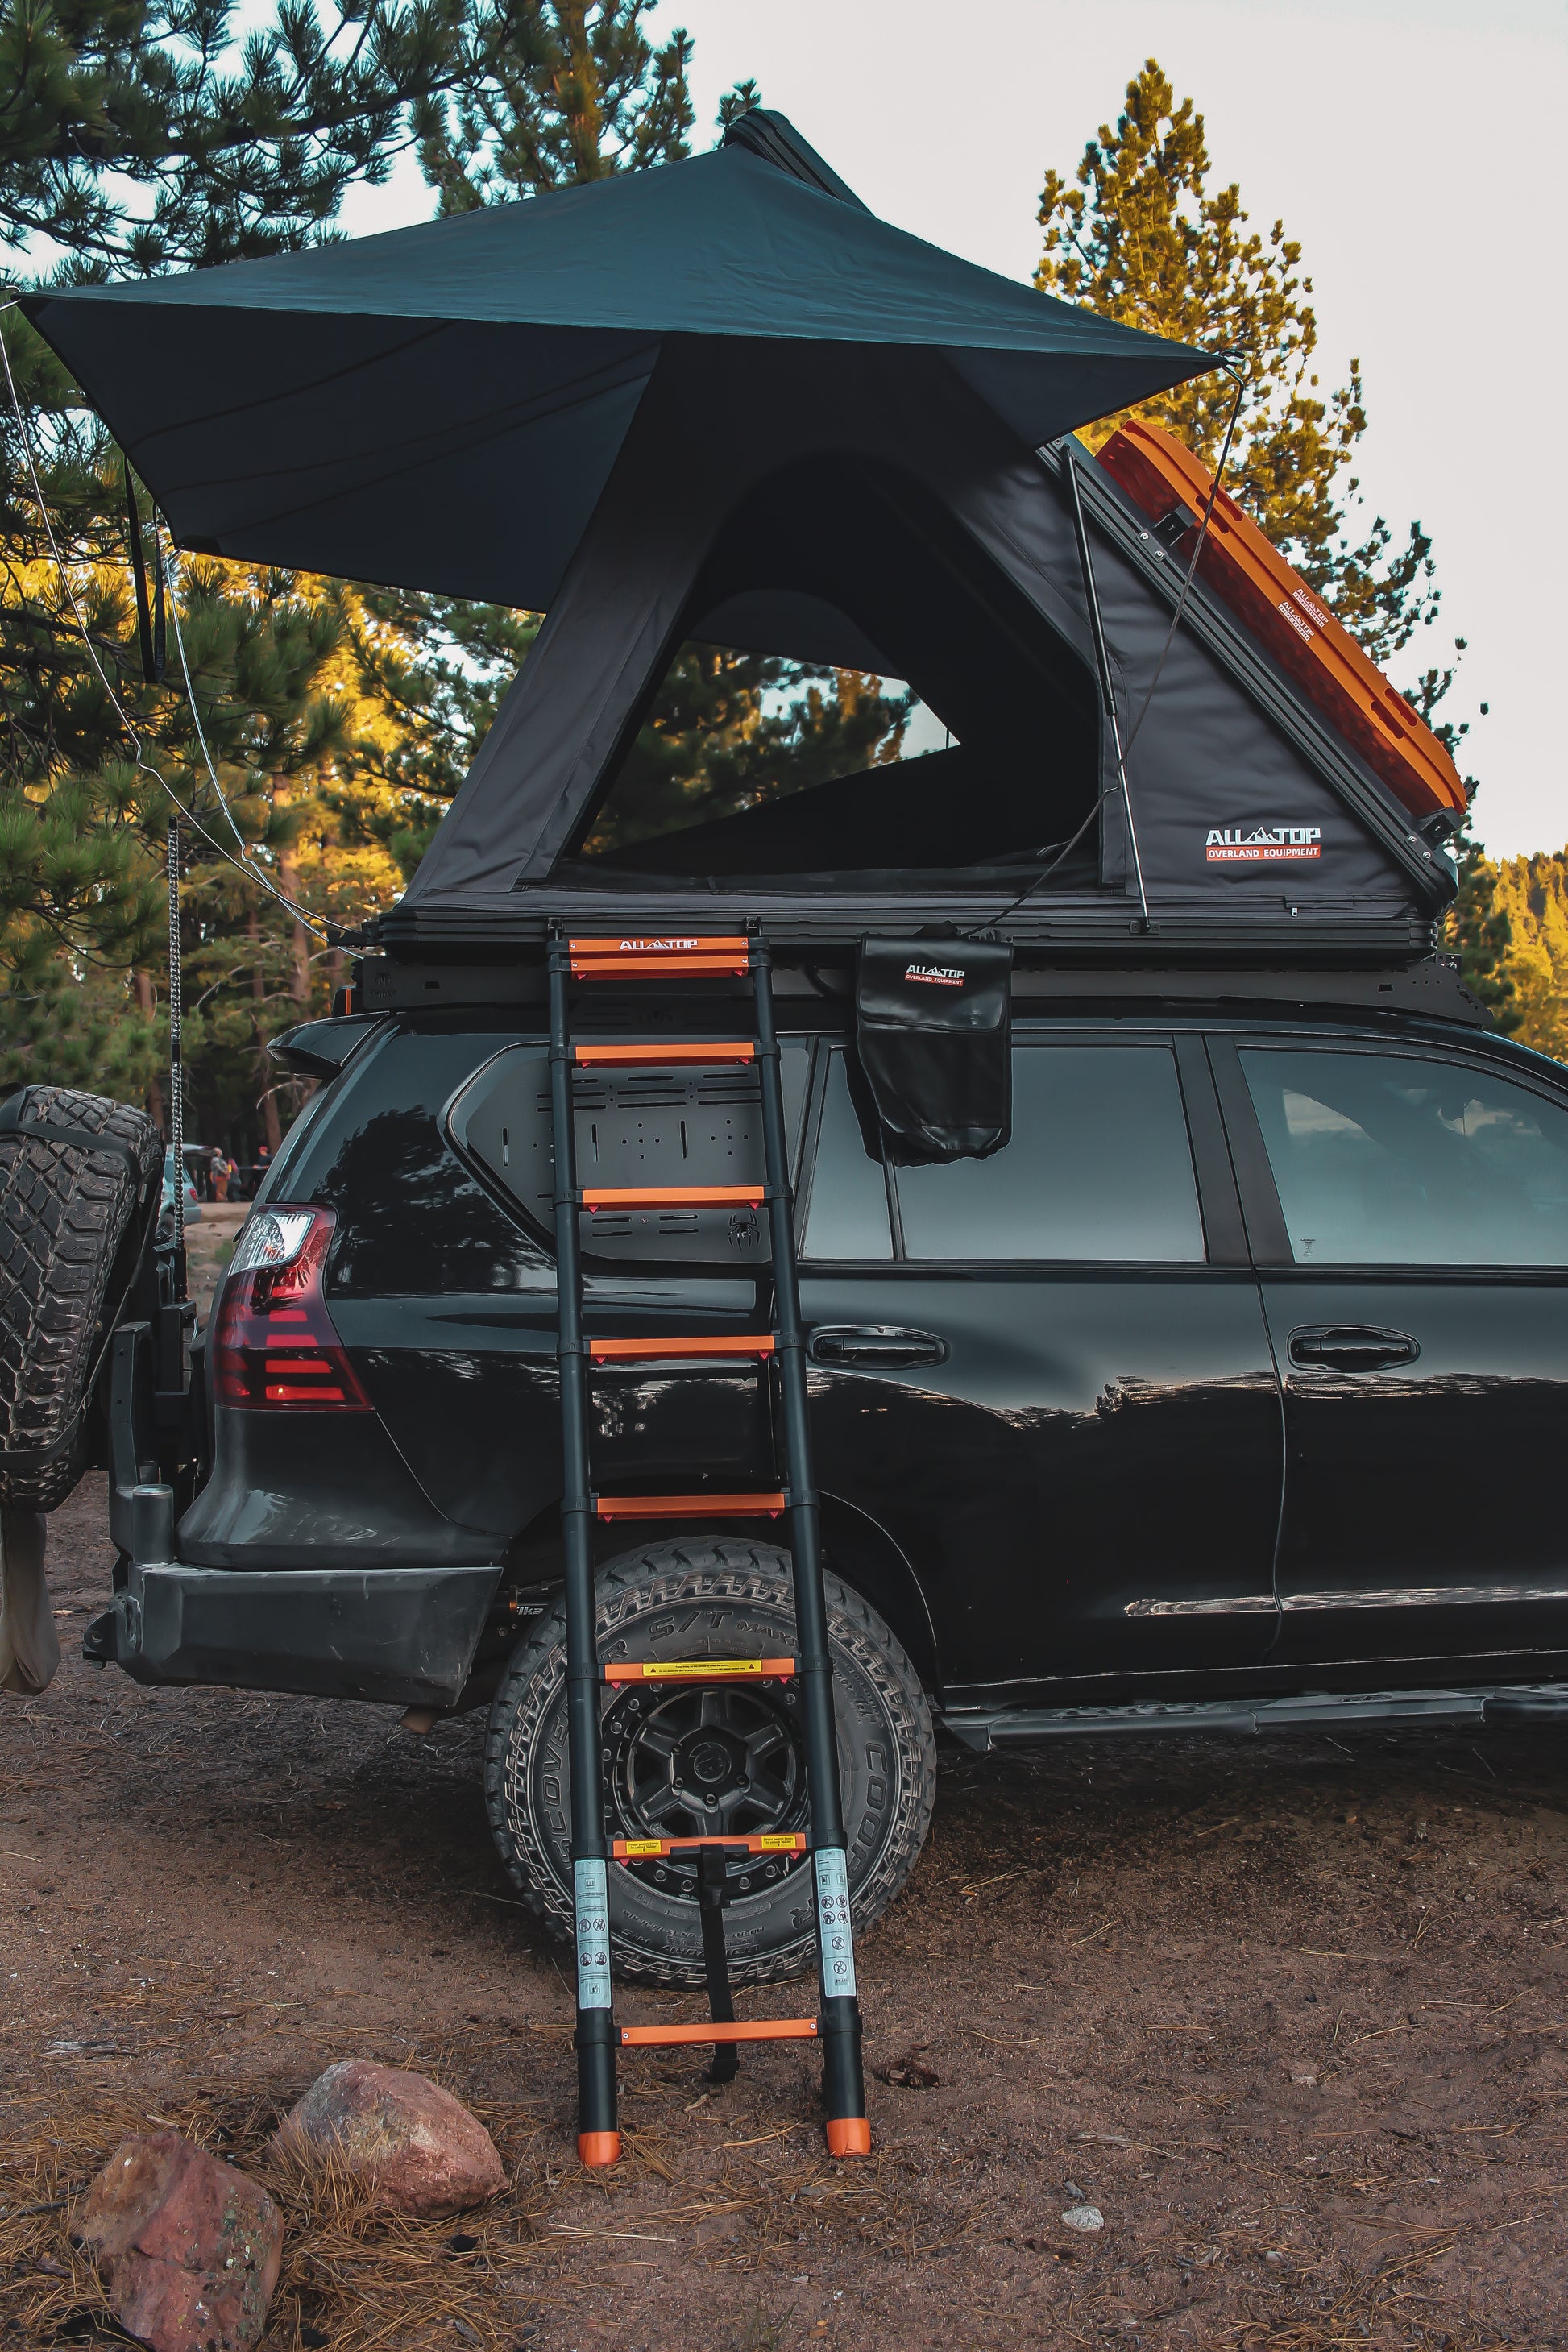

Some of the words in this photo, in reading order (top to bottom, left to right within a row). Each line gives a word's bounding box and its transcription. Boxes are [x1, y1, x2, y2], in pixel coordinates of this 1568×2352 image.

[1208, 849, 1259, 859] OVERLAND
[1263, 848, 1319, 858] EQUIPMENT
[934, 977, 963, 985] EQUIPMENT
[649, 1610, 734, 1642] S/T
